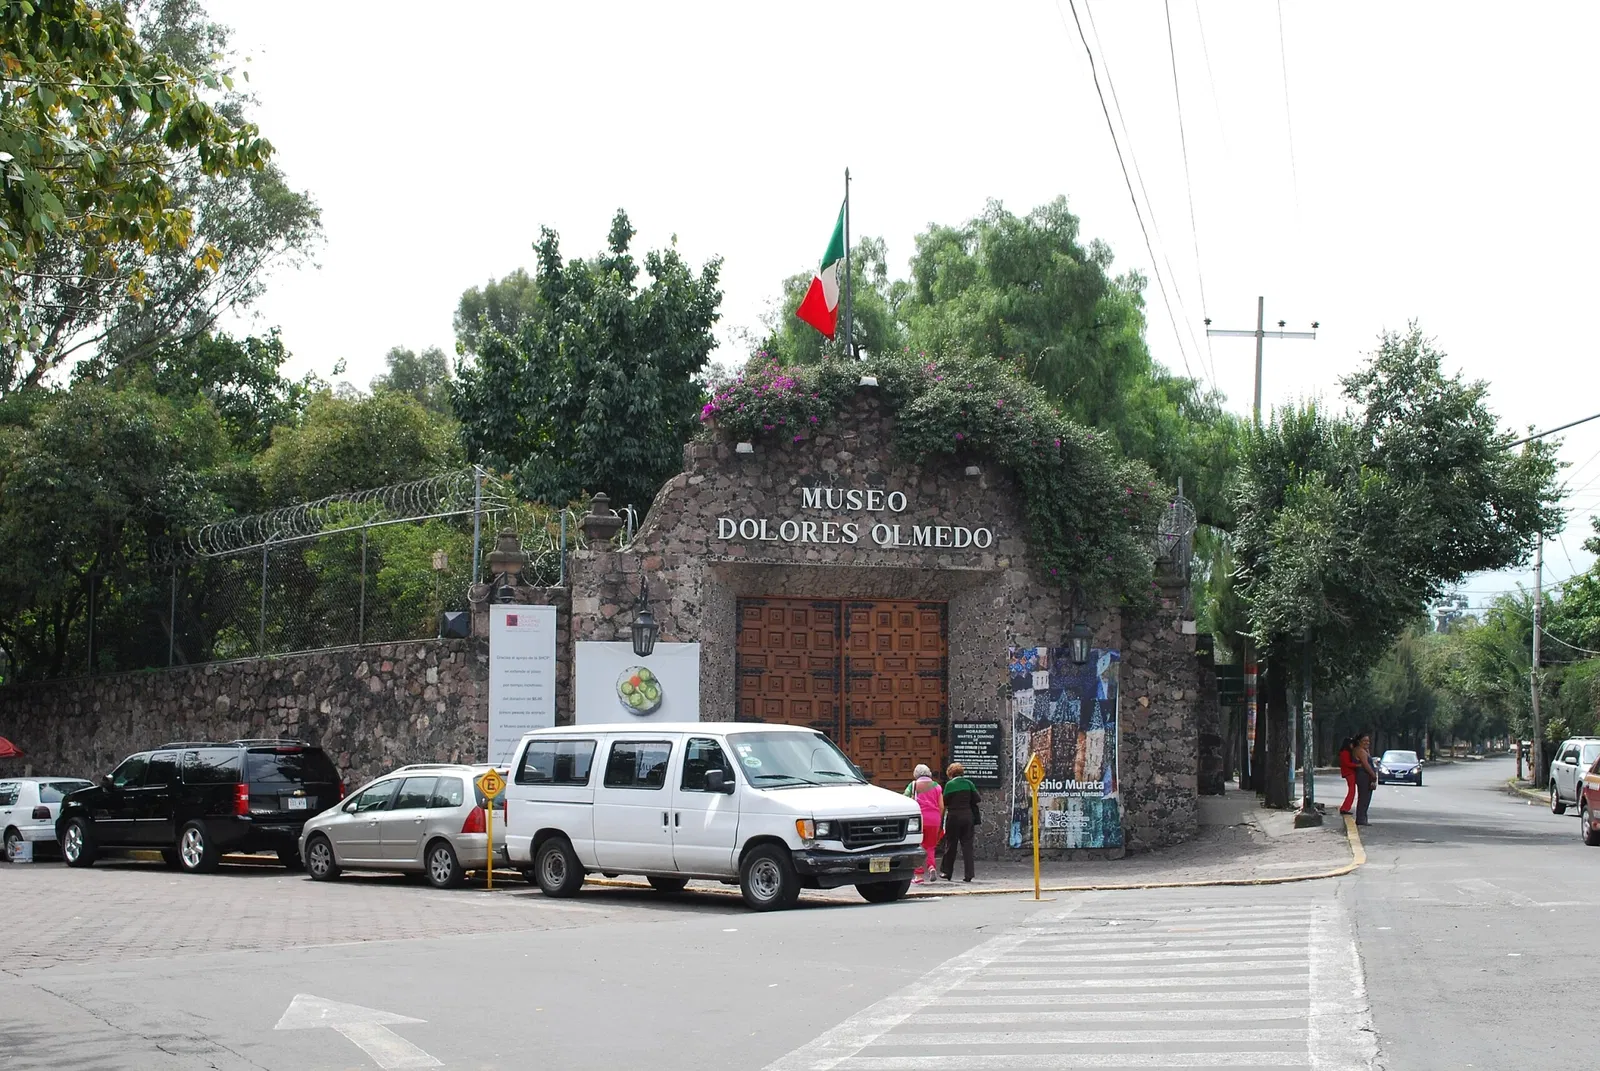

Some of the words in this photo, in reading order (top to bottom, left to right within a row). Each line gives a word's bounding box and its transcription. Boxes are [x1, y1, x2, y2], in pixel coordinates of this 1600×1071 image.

[801, 487, 907, 512] MUSEO
[717, 517, 859, 544] DOLORES
[871, 523, 993, 548] OLMEDO
[1065, 779, 1105, 790] Murata
